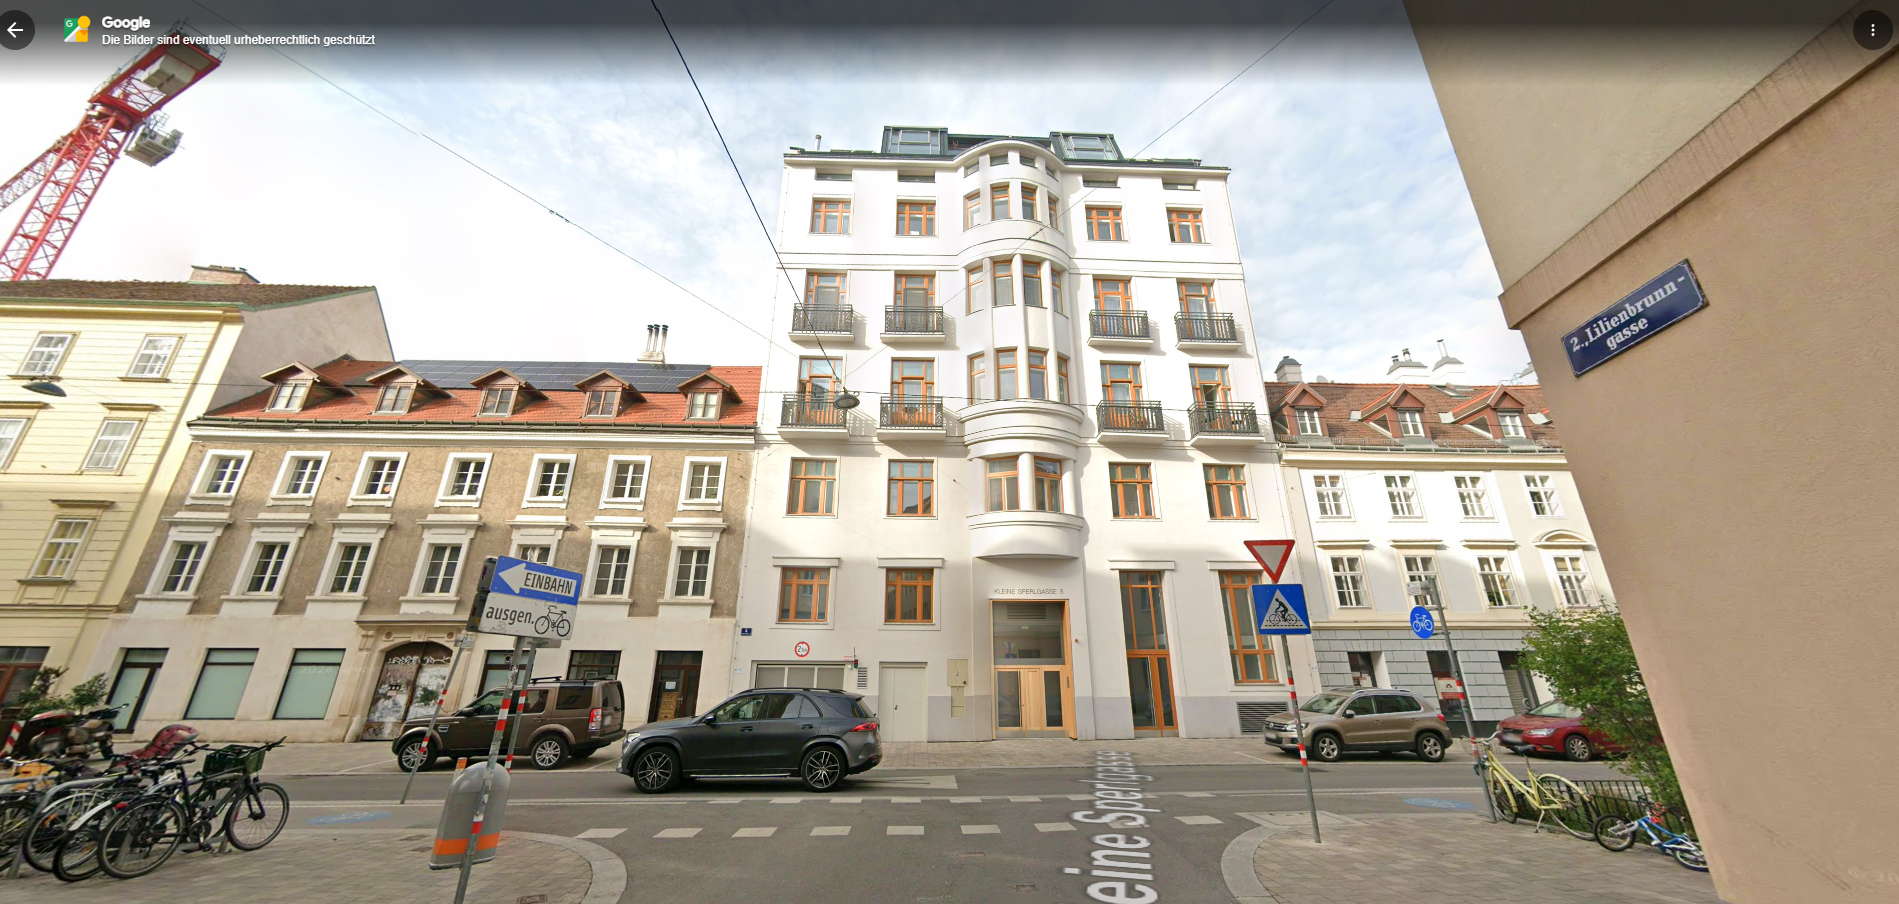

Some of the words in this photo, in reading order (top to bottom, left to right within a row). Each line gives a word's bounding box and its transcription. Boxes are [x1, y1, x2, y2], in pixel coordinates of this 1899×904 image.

[1606, 317, 1649, 351] gasse
[523, 572, 573, 595] EINBAHN
[485, 606, 535, 625] ausgen.
